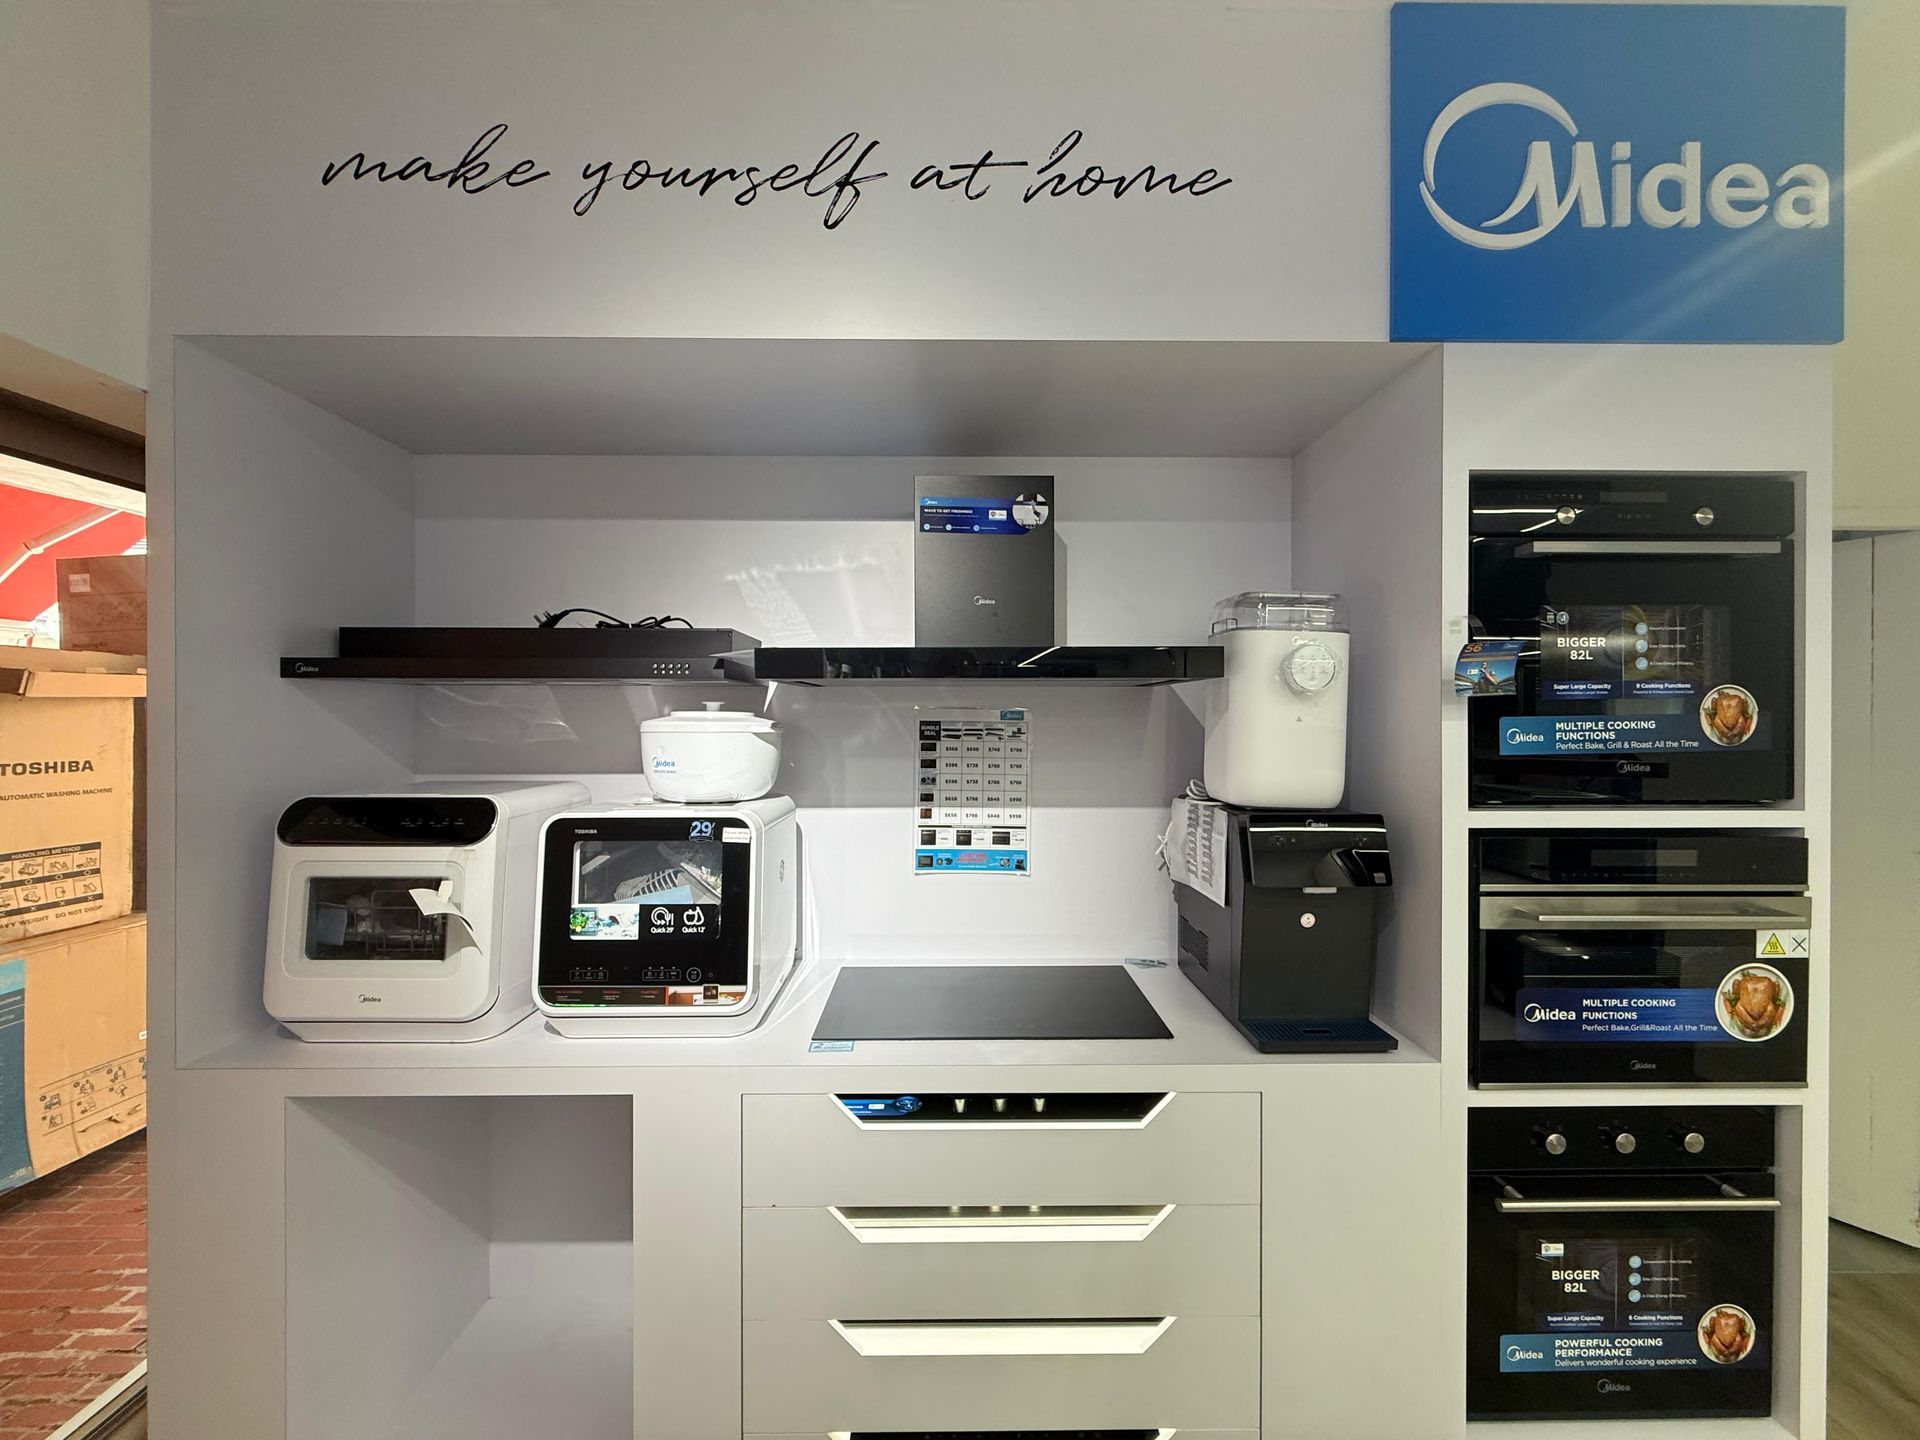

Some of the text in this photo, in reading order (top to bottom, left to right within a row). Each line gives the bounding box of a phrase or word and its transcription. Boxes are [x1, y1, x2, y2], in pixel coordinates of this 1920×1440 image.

[1419, 82, 1830, 250] Midea
[322, 124, 1233, 229] make yourself at home
[974, 595, 995, 605] Midea
[1557, 637, 1606, 648] BIGGER
[1570, 650, 1593, 660] 82L
[295, 663, 319, 673] Midea
[1556, 720, 1656, 731] MULTIPLE COOKING
[1507, 728, 1544, 745] Midea
[1556, 732, 1616, 740] FUNCTIONS
[1556, 742, 1584, 750] Perfect
[1585, 742, 1606, 750] Bake,
[1607, 741, 1622, 749] Grill
[1654, 740, 1664, 748] All
[1666, 740, 1678, 748] the
[652, 756, 675, 768] Midea
[1617, 760, 1650, 774] Midea
[0, 760, 94, 776] TOSHIBA
[46, 789, 80, 798] WASHING
[82, 788, 112, 796] MACHINE
[1306, 820, 1328, 828] Midea
[11, 846, 81, 860] HANDLING METHOD
[19, 916, 48, 926] WEIGHT
[68, 908, 82, 916] NOT
[84, 905, 103, 913] DROP
[359, 994, 381, 1003] Midea
[1582, 999, 1676, 1007] MULTIPLE COOKING
[1524, 1003, 1576, 1022] Midea
[1582, 1011, 1638, 1020] FUNCTIONS
[1630, 1060, 1656, 1070] Midea
[1552, 1270, 1600, 1280] BIGGER
[1564, 1283, 1587, 1292] 82L
[1555, 1338, 1663, 1348] POWERFUL COOKING
[1507, 1346, 1543, 1362] Midea
[1555, 1348, 1632, 1358] PERFORMANCE
[1586, 1358, 1623, 1366] wonderful
[1625, 1358, 1655, 1367] cooking
[1656, 1358, 1697, 1367] experience
[1597, 1378, 1630, 1393] Midea
